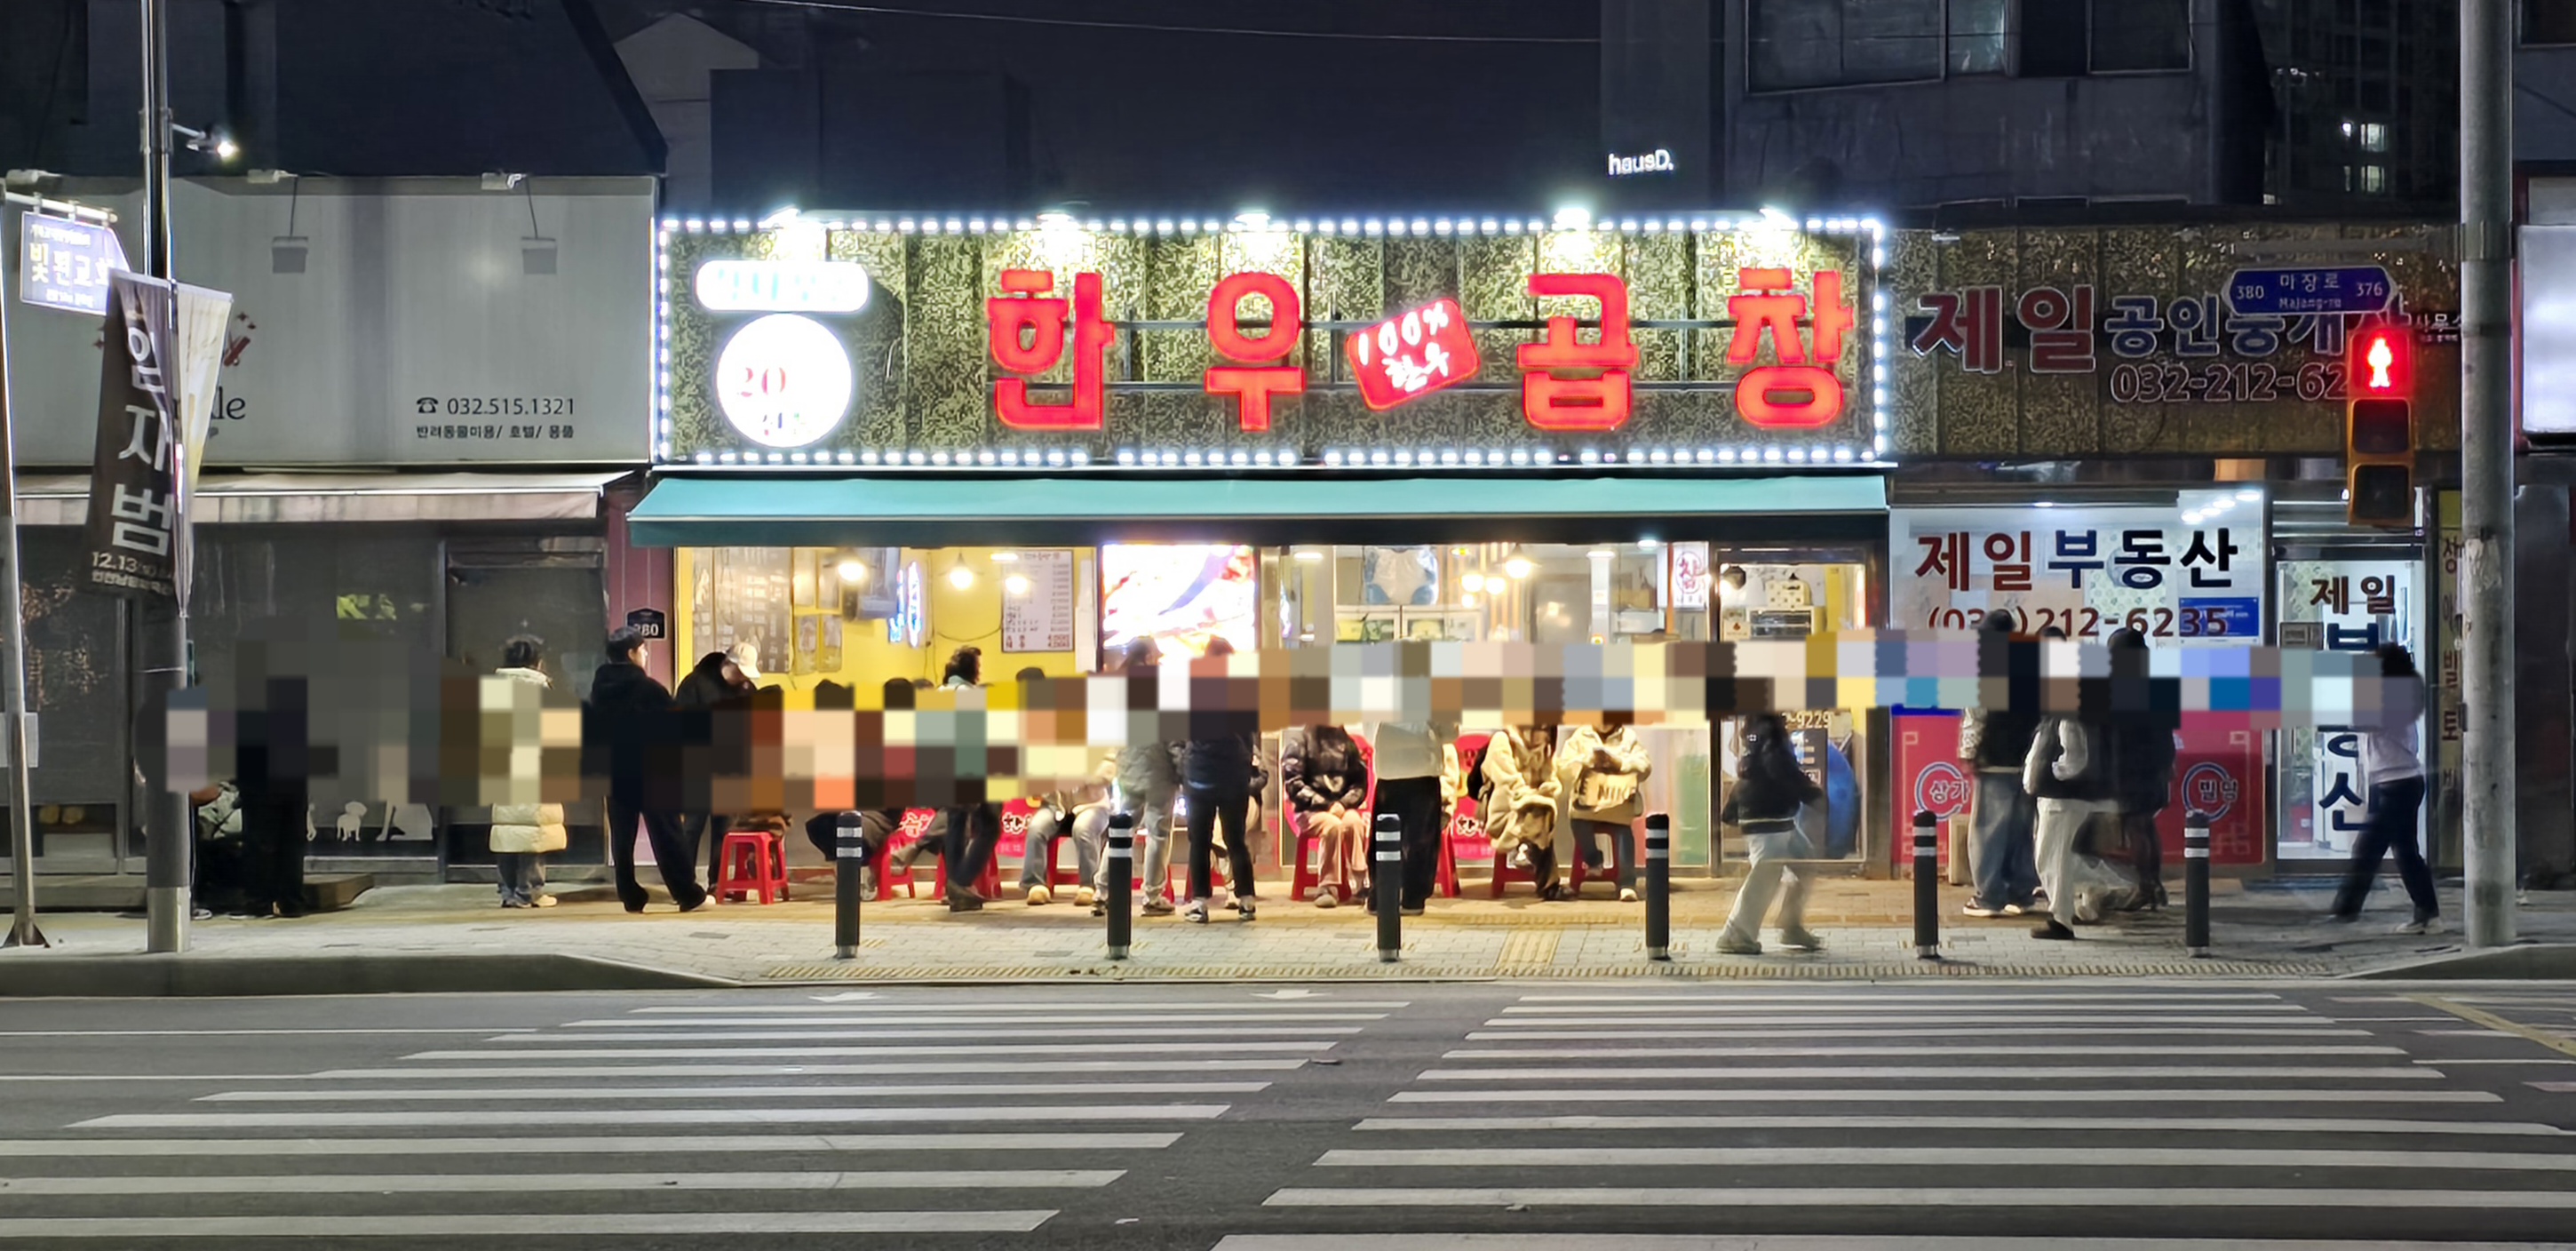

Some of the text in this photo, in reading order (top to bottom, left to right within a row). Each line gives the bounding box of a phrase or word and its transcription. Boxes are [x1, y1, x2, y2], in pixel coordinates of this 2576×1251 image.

[2236, 284, 2265, 300] 380
[2279, 273, 2341, 292] 마장로
[2356, 282, 2384, 297] 376
[1357, 302, 1450, 366] 100%
[2110, 362, 2348, 403] 032-212-62
[446, 397, 575, 416] 032.515.1321
[2310, 575, 2396, 616] 제일
[1928, 606, 2228, 638] (03)212-6235
[1929, 778, 1970, 804] 상가
